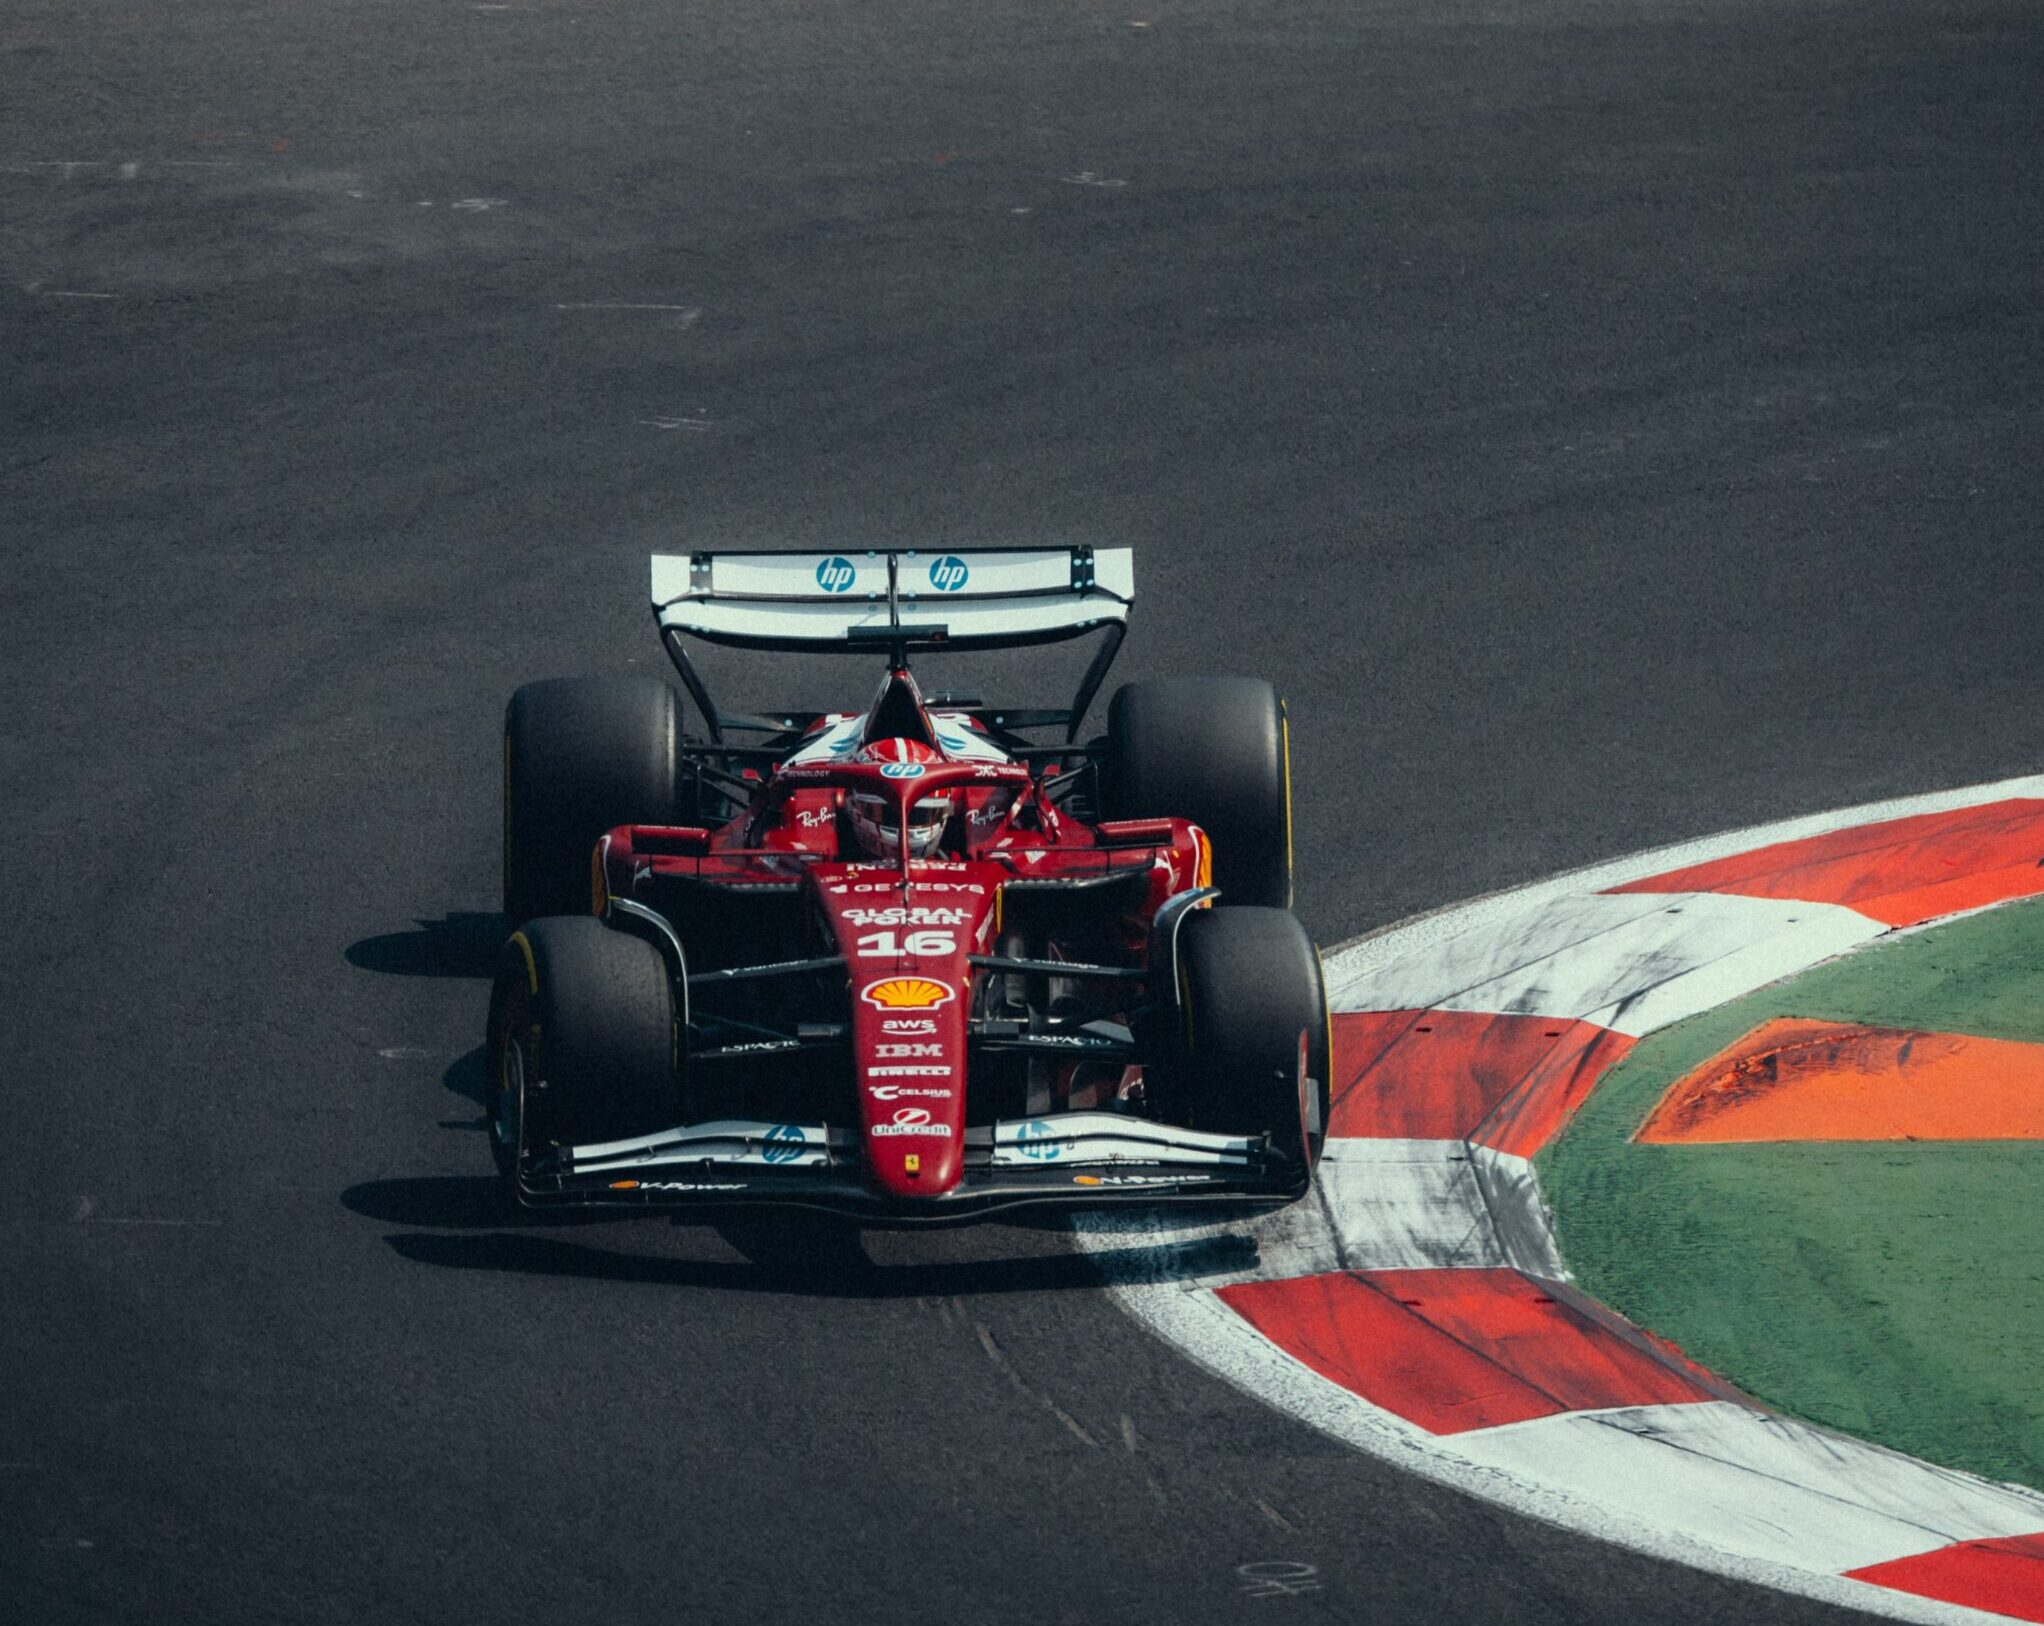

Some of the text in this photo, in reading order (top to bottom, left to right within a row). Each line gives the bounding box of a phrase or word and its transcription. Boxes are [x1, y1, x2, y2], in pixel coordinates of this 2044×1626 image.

[820, 557, 852, 592] hp
[932, 556, 966, 591] hp
[884, 764, 921, 778] hp
[841, 907, 973, 918] GLOBAL
[852, 916, 962, 926] POKER
[857, 930, 957, 957] 16
[882, 1020, 936, 1030] aws
[876, 1044, 943, 1057] IBM
[898, 1089, 952, 1098] CELSIUS
[871, 1124, 952, 1137] UniCredit
[640, 1182, 748, 1190] V-Power
